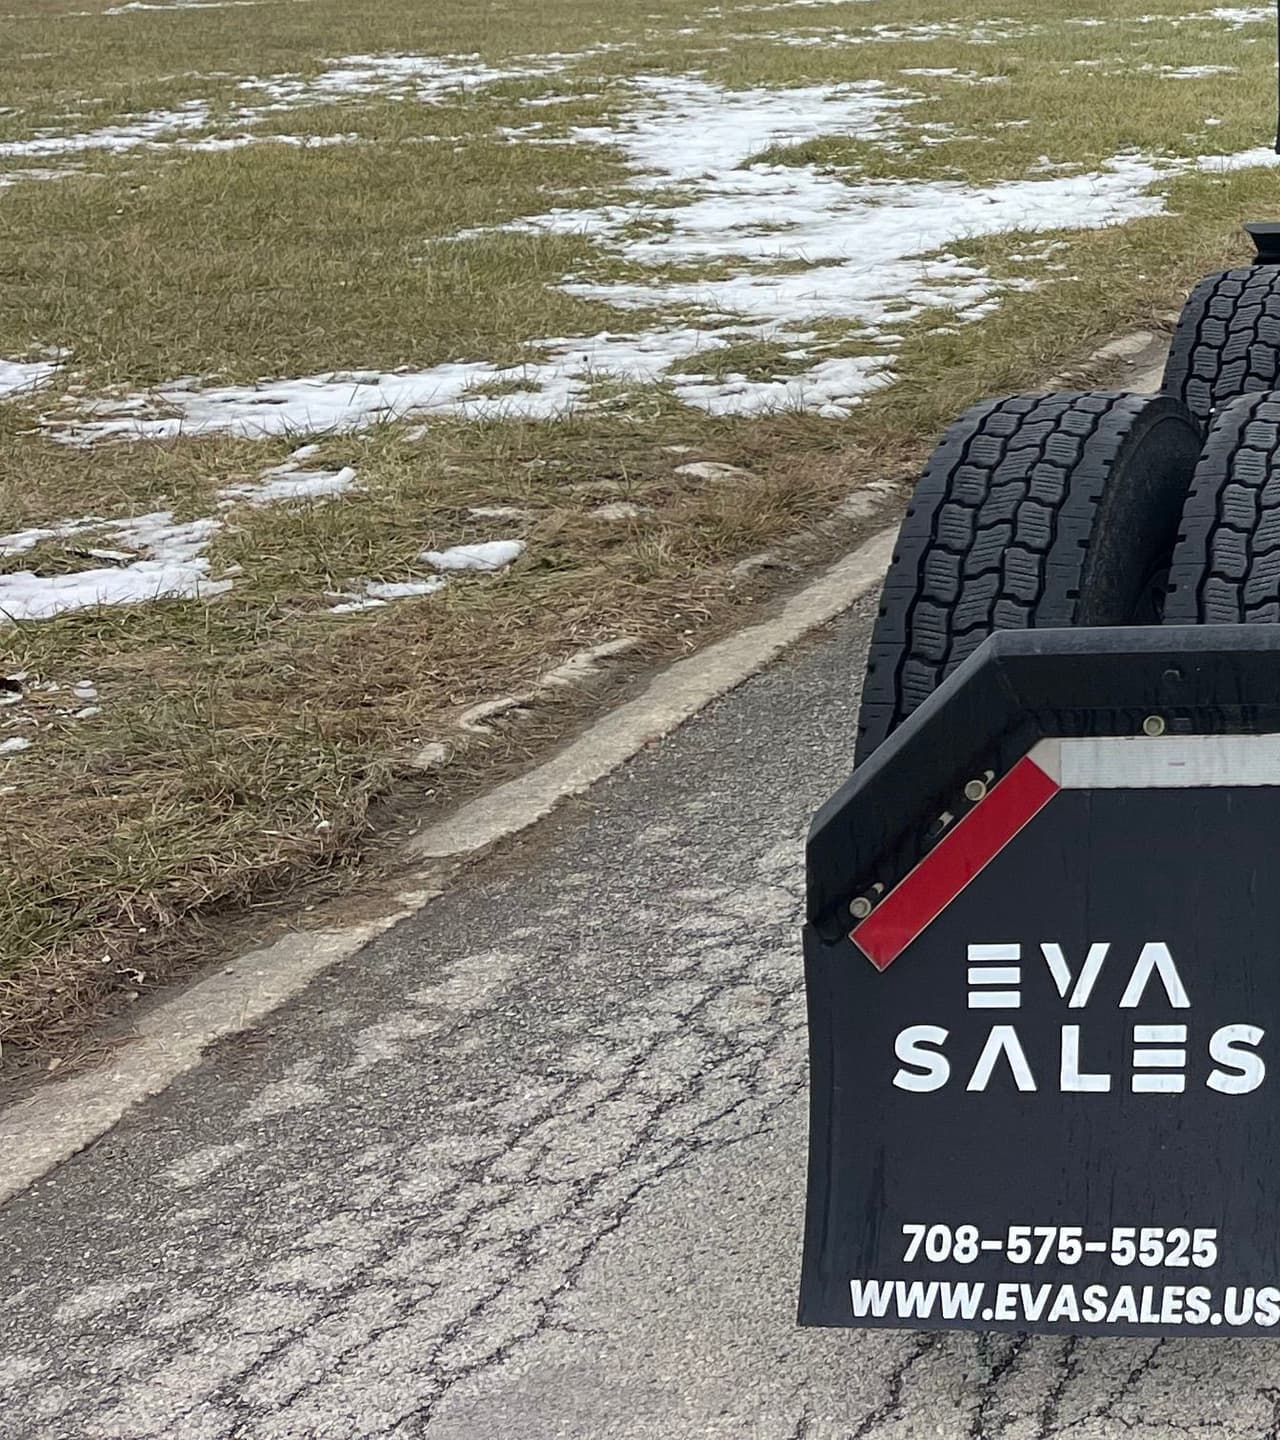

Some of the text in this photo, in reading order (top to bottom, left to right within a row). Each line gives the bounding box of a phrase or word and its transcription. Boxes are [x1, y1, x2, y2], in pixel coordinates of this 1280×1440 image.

[967, 942, 1191, 1009] EVA
[892, 1024, 1266, 1095] SALES
[902, 1224, 1218, 1268] 708-575-5525
